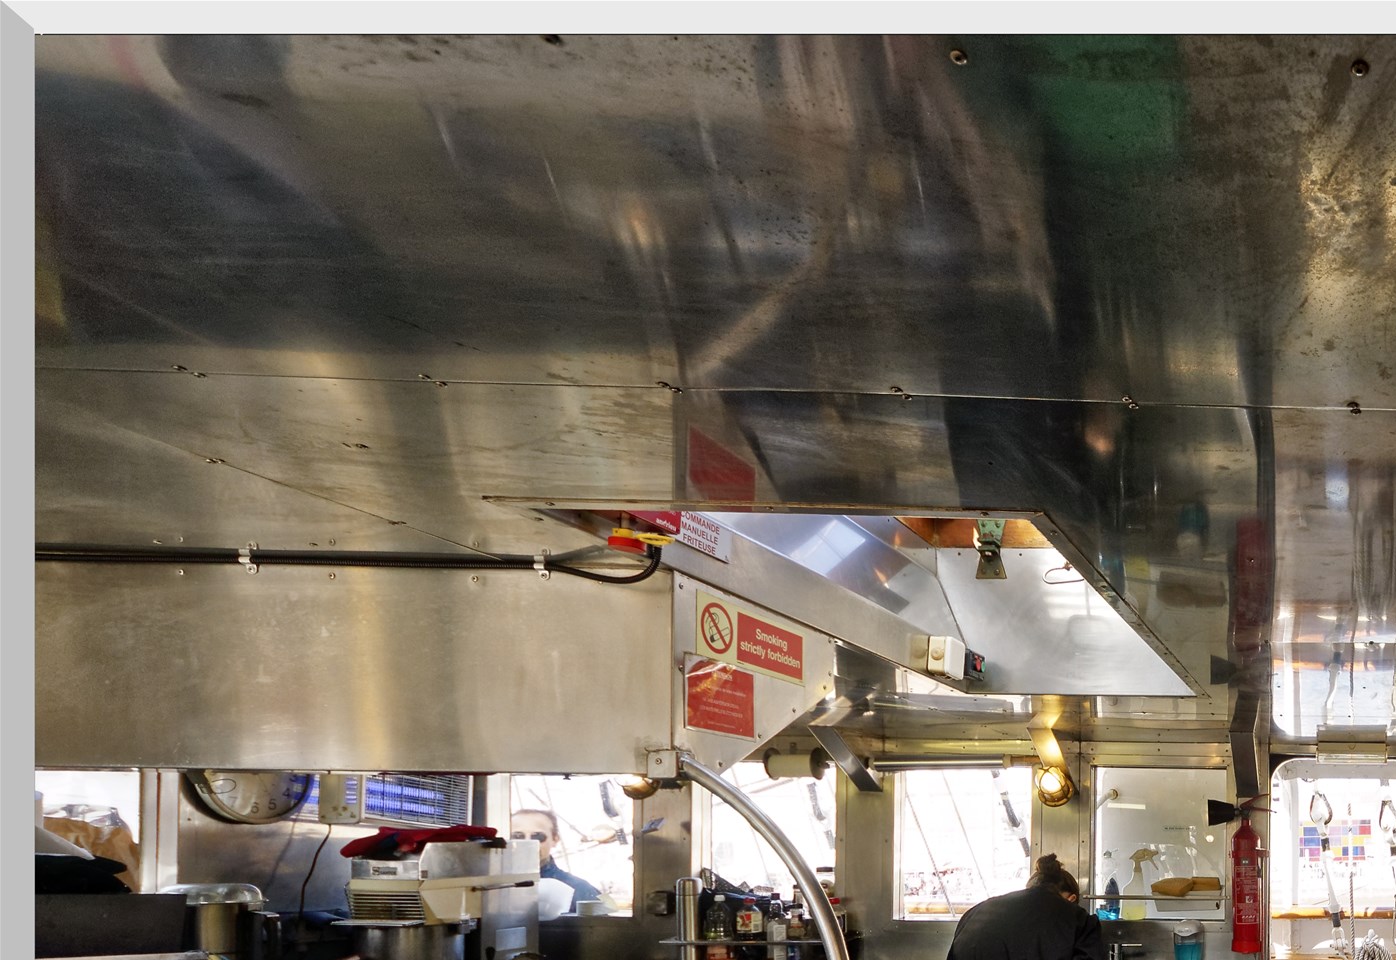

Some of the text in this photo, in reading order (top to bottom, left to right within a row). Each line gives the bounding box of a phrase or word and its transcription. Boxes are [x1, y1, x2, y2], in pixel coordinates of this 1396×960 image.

[681, 521, 719, 545] MANUELLE
[683, 533, 717, 555] FRITEUSE
[756, 628, 788, 652] Smoking
[740, 640, 801, 669] strictly forbidden
[283, 787, 290, 797] 4
[251, 801, 259, 814] 6
[268, 798, 277, 810] 5
